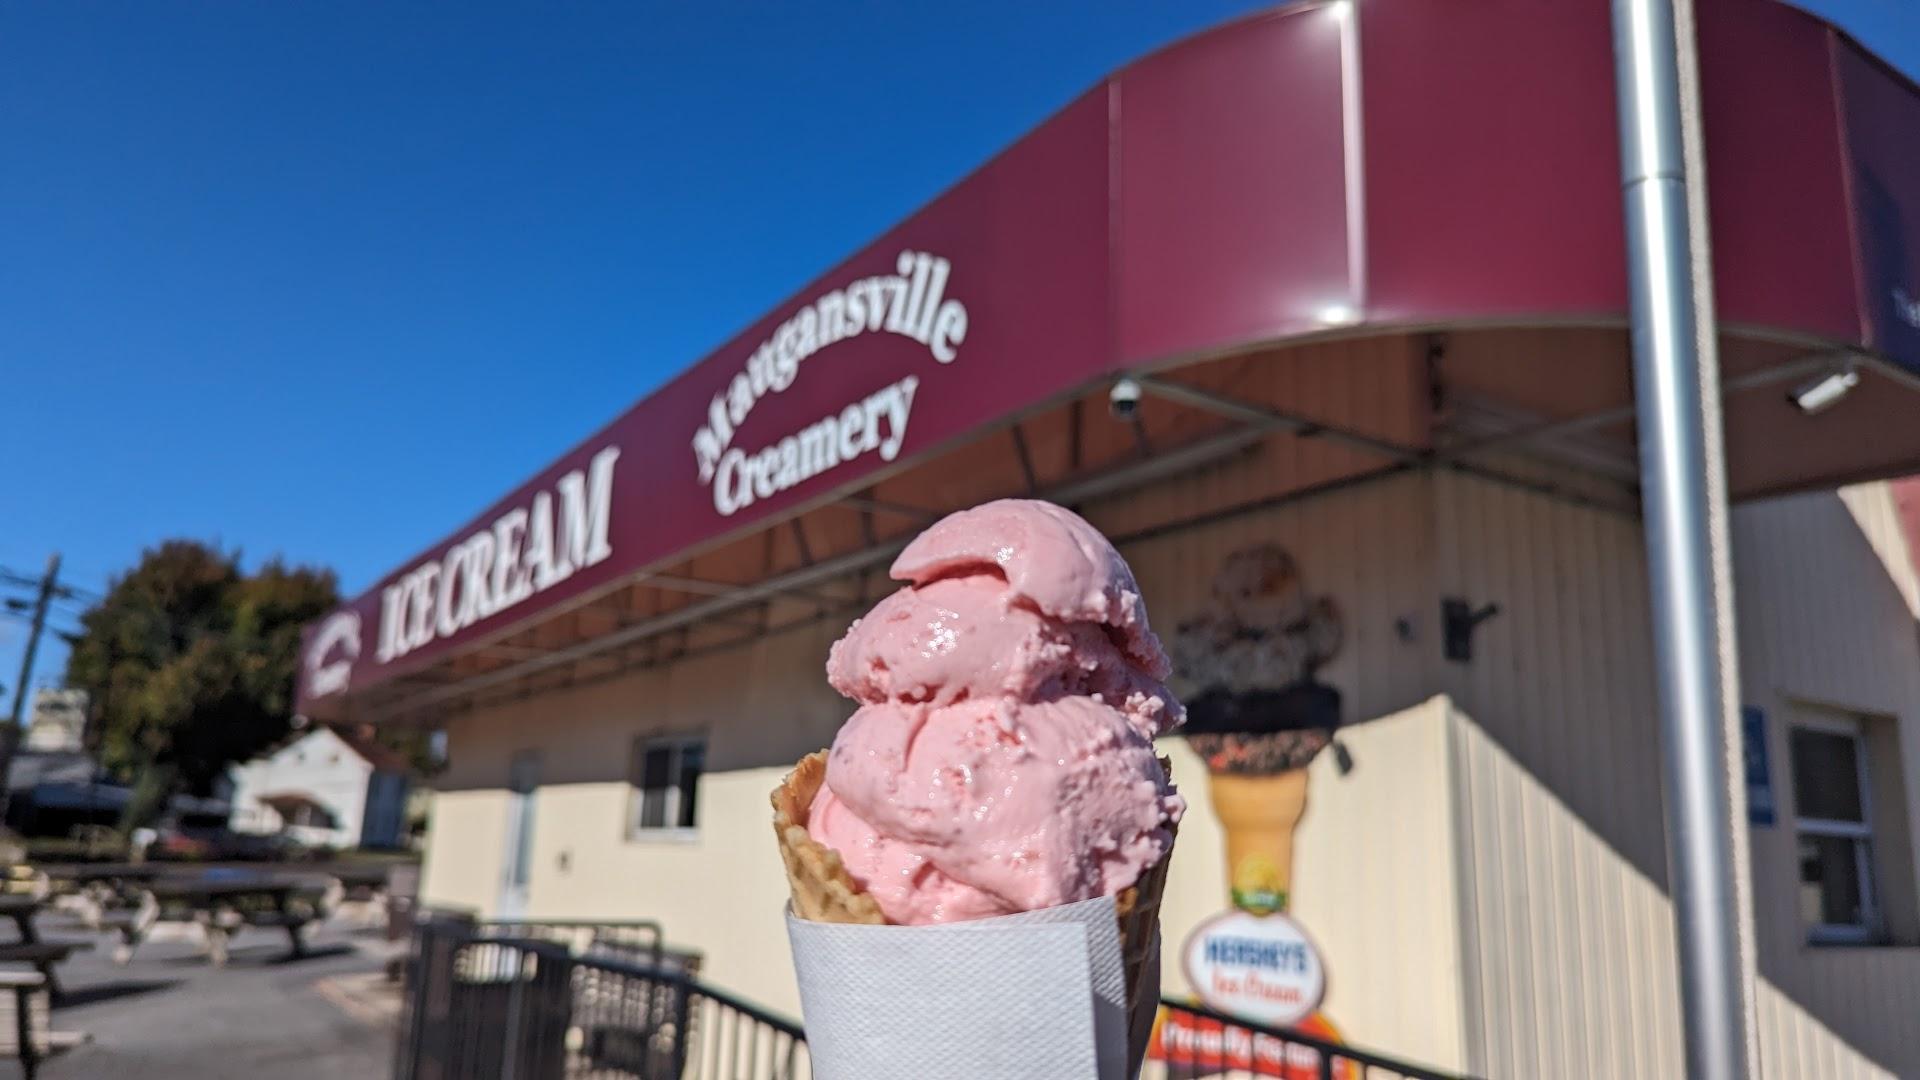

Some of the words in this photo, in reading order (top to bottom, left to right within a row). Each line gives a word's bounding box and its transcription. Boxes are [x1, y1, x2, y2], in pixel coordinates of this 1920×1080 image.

[692, 249, 968, 484] Maugansville
[714, 375, 919, 516] Creamery
[376, 560, 442, 664] ICE
[436, 445, 621, 637] CREAM
[1205, 937, 1307, 973] HERSHEY'S
